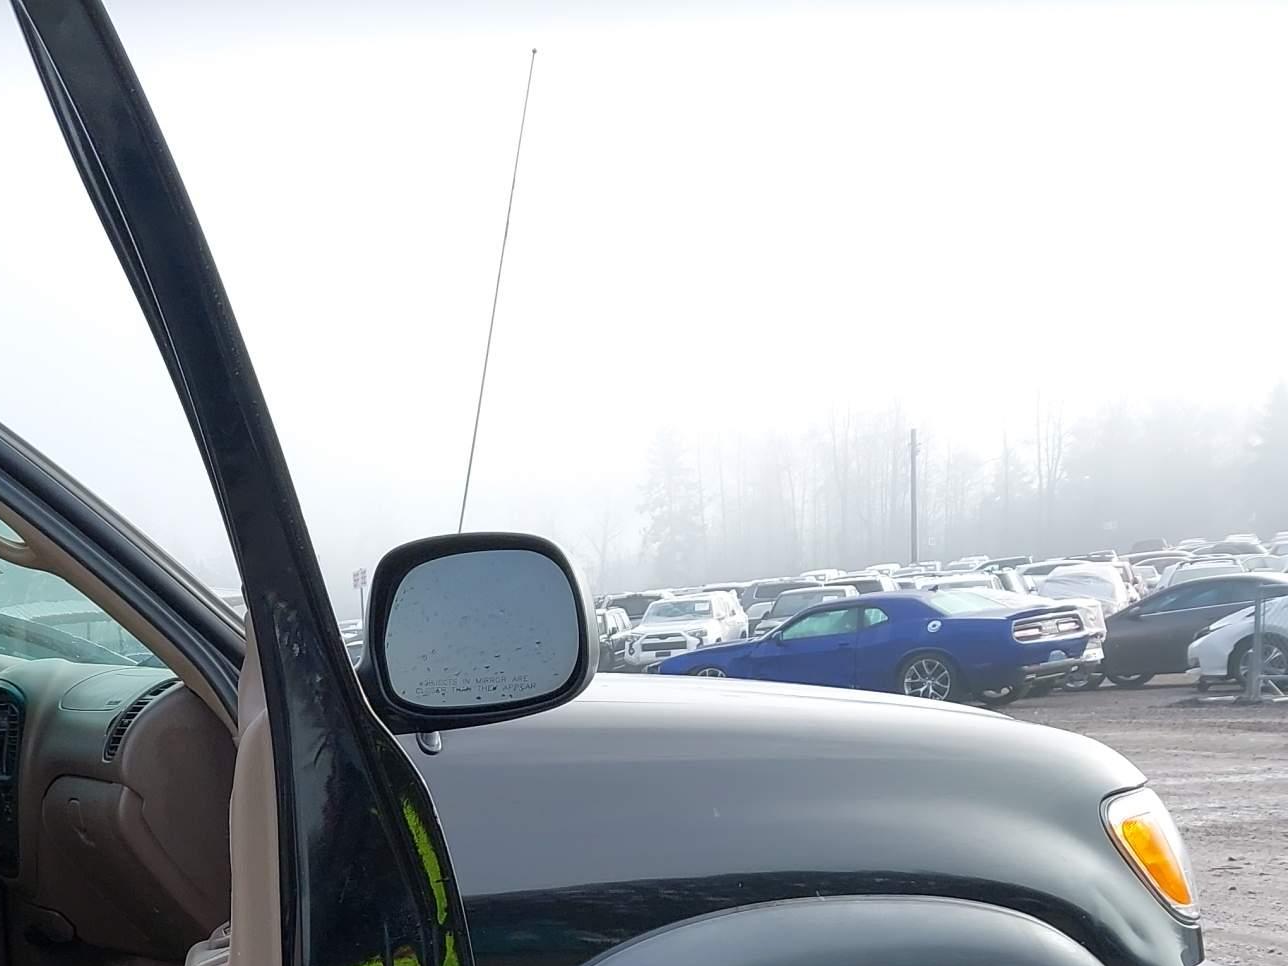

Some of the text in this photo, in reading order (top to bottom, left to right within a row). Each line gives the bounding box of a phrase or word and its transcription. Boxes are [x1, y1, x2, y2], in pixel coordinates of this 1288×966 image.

[461, 678, 471, 686] IN
[475, 675, 507, 684] MIRROR
[512, 674, 529, 683] ARE
[503, 681, 537, 691] APPEAR
